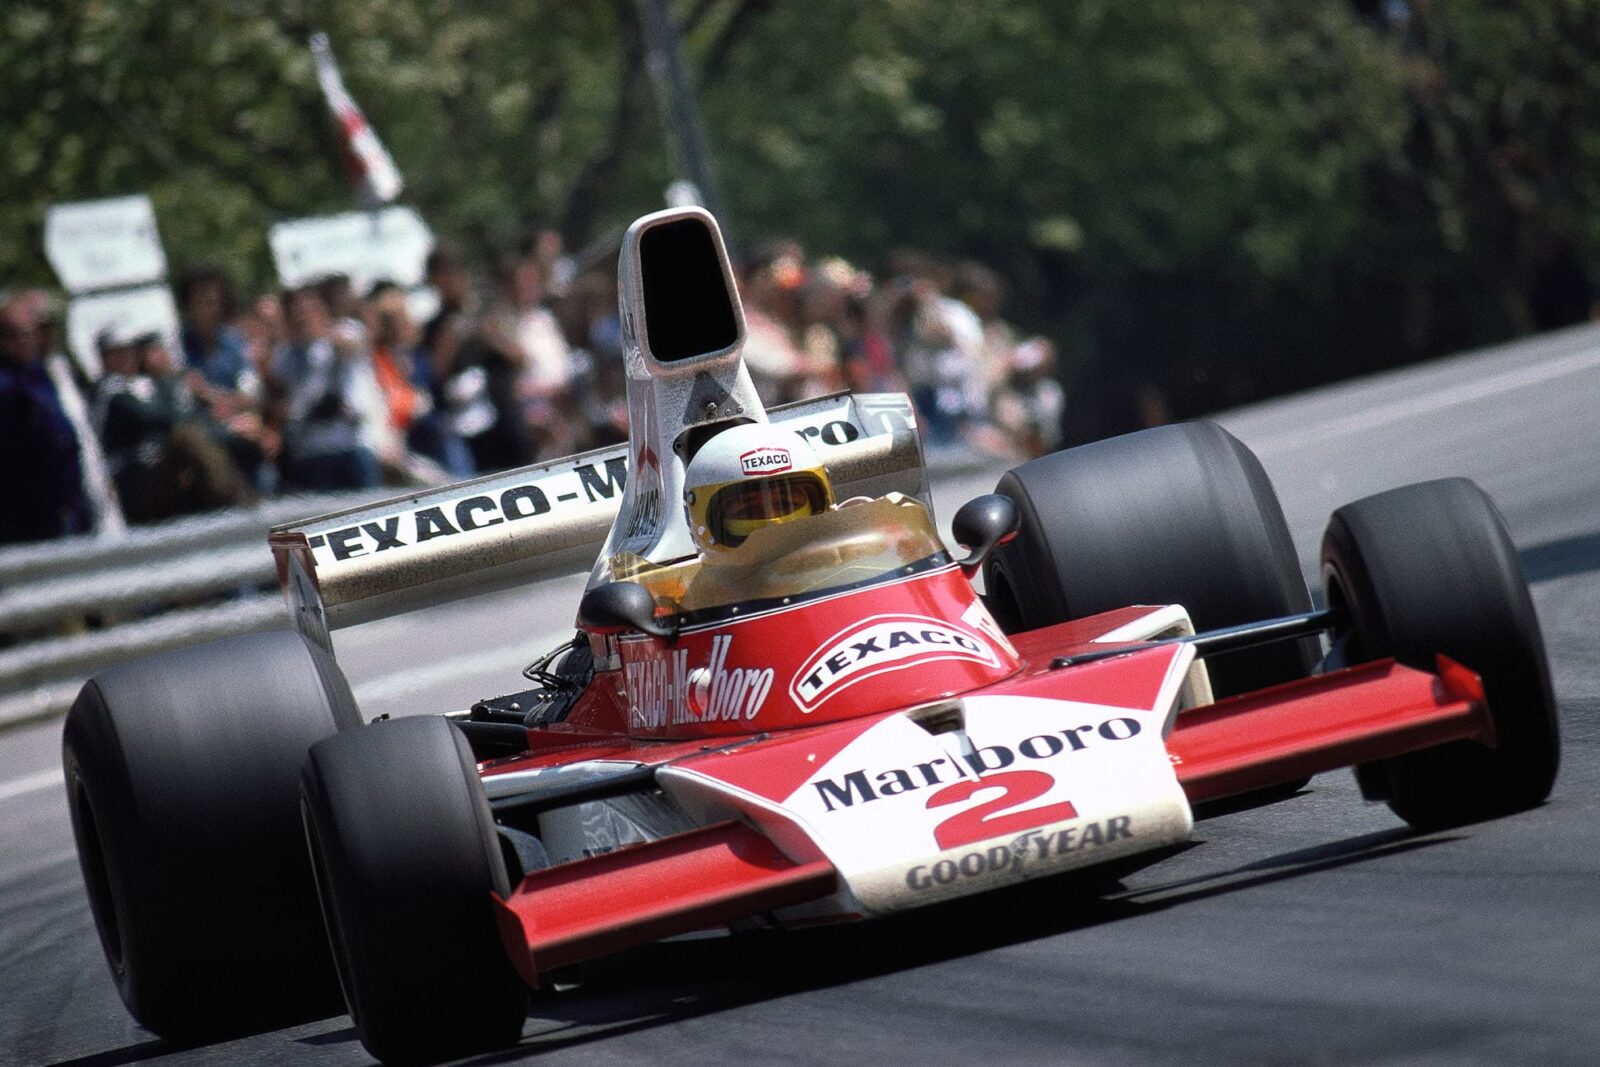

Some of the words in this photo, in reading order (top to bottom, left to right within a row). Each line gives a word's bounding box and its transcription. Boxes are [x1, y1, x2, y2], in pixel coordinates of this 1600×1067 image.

[743, 453, 789, 469] TEXACO
[801, 630, 981, 690] TEXACO
[809, 716, 1142, 813] Marlboro
[925, 769, 1079, 851] 2
[905, 815, 1133, 892] GOODYEAR
